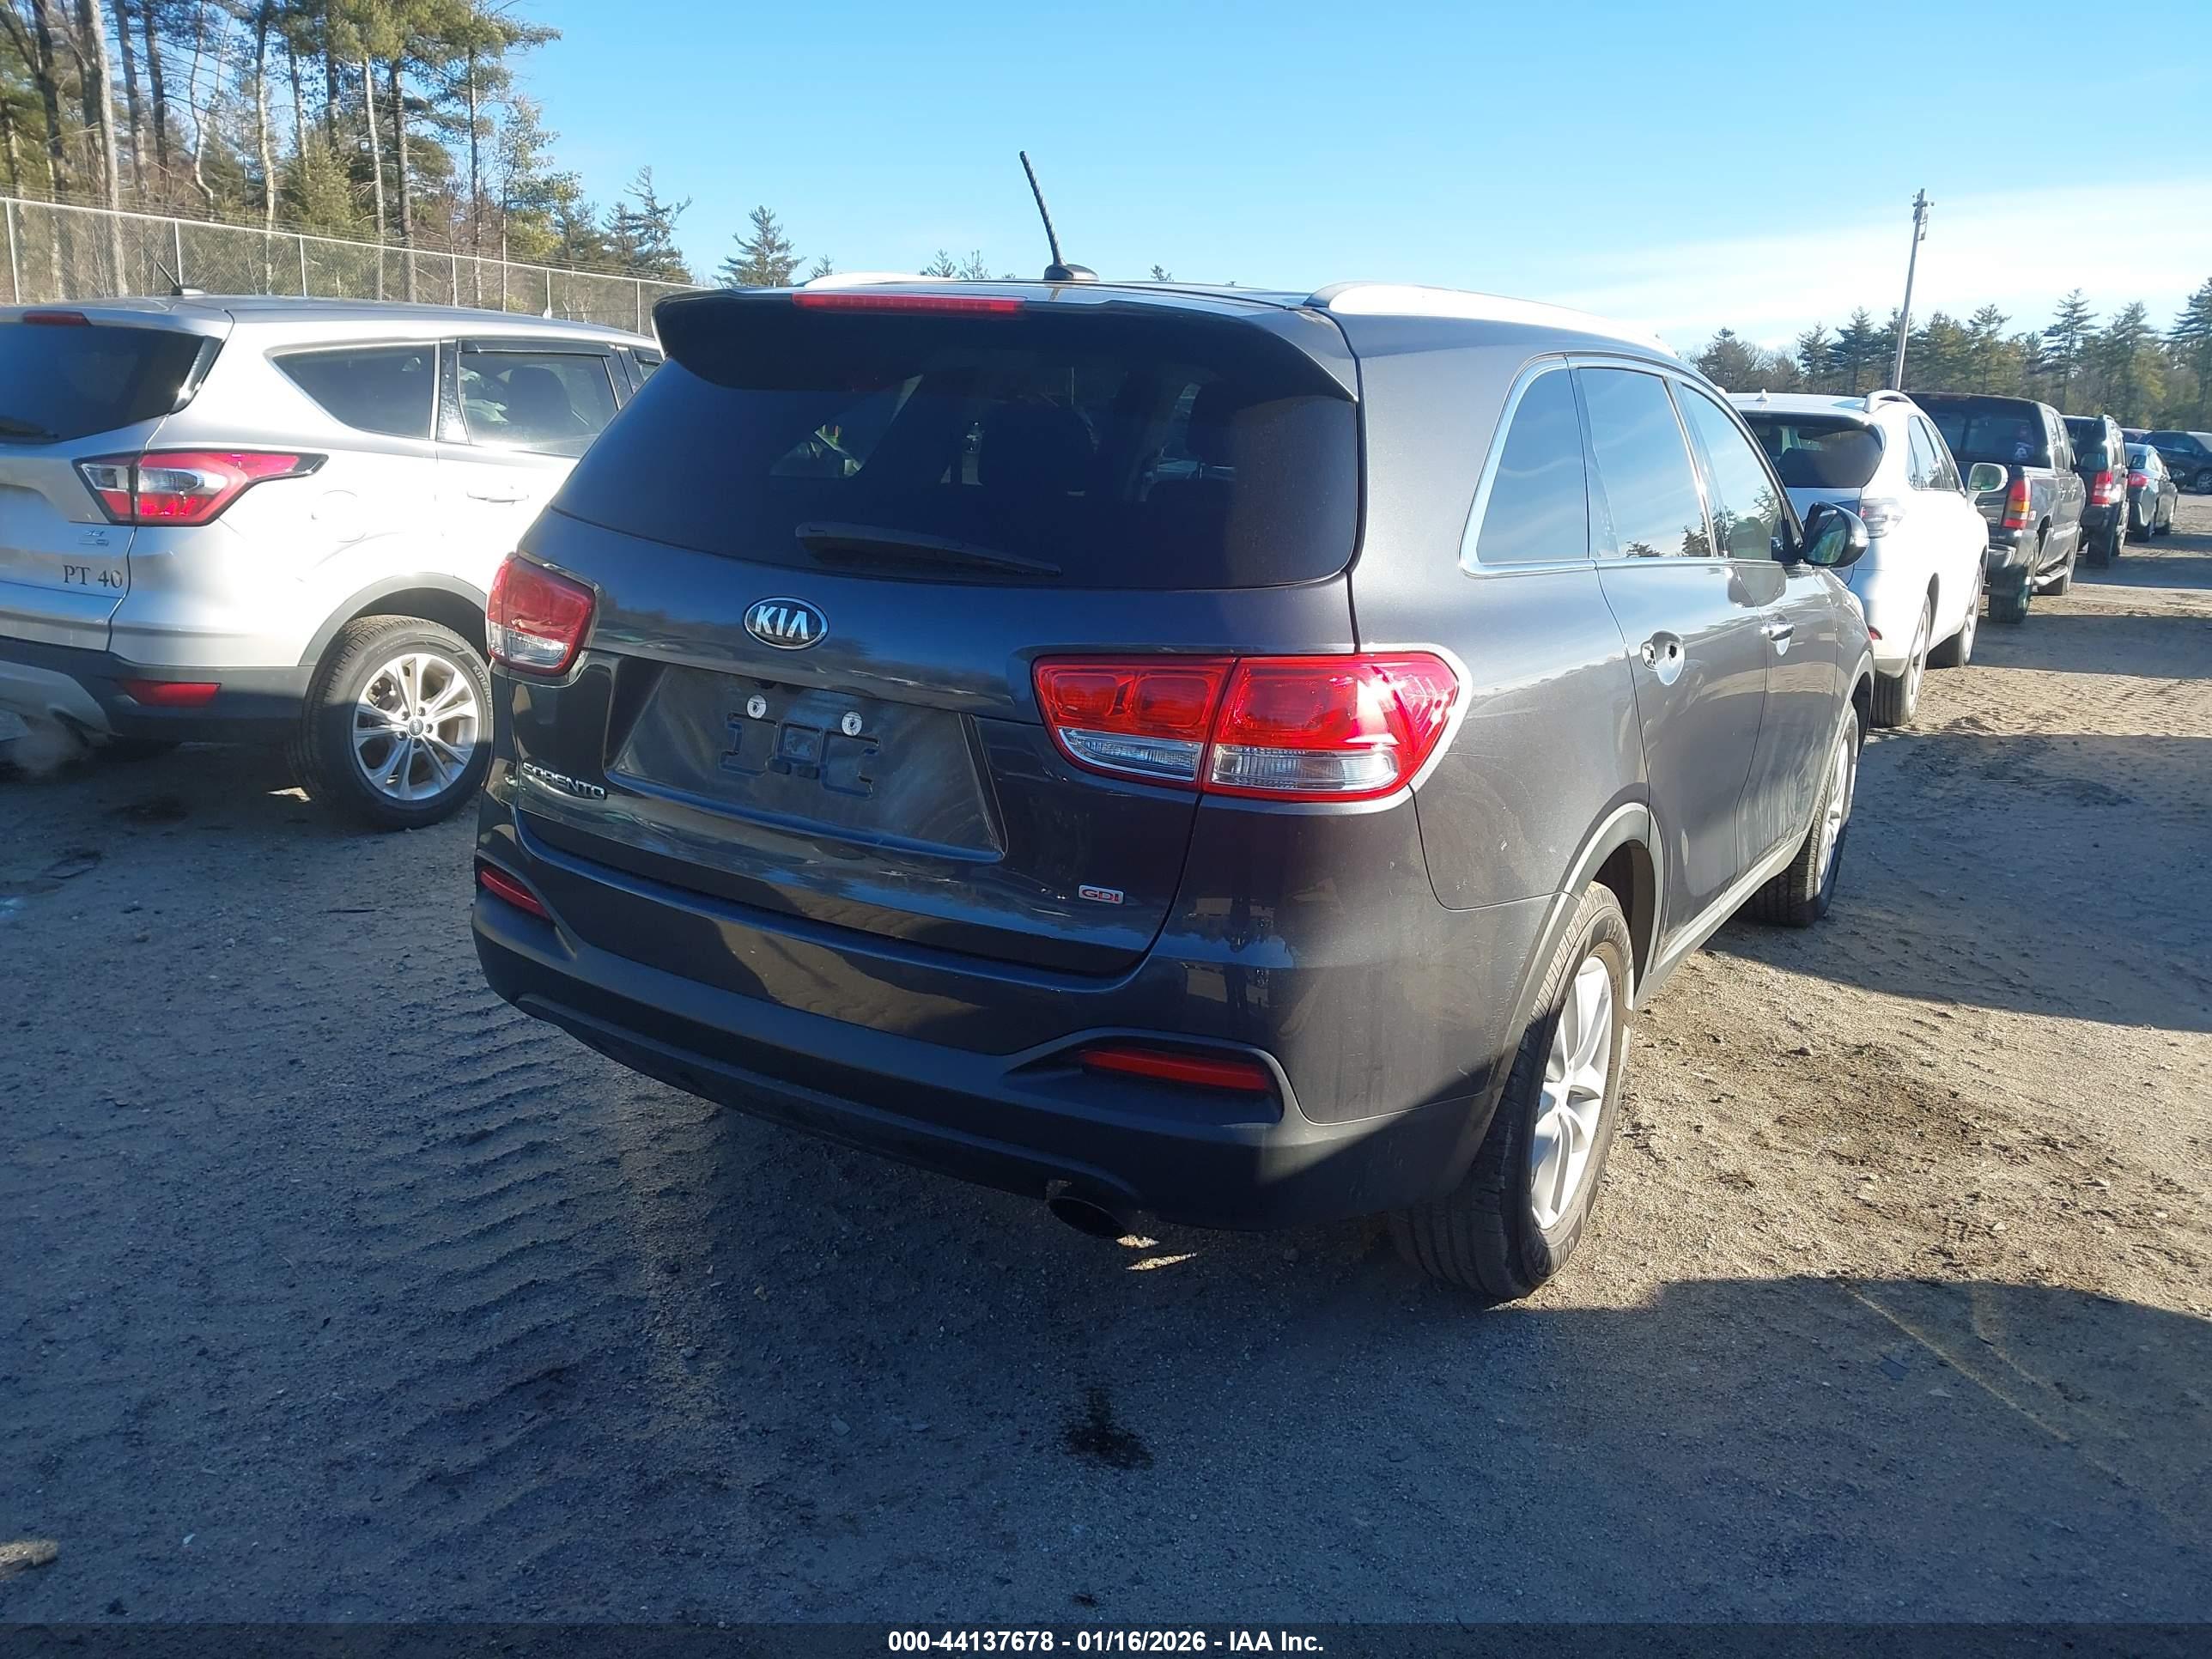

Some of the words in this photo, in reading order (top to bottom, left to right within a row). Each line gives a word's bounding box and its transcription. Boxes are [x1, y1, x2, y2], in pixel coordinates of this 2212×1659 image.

[63, 564, 91, 586] PT
[97, 569, 123, 588] 40
[755, 605, 809, 641] KIA
[522, 762, 606, 799] SORENTO
[1081, 889, 1120, 902] GDI
